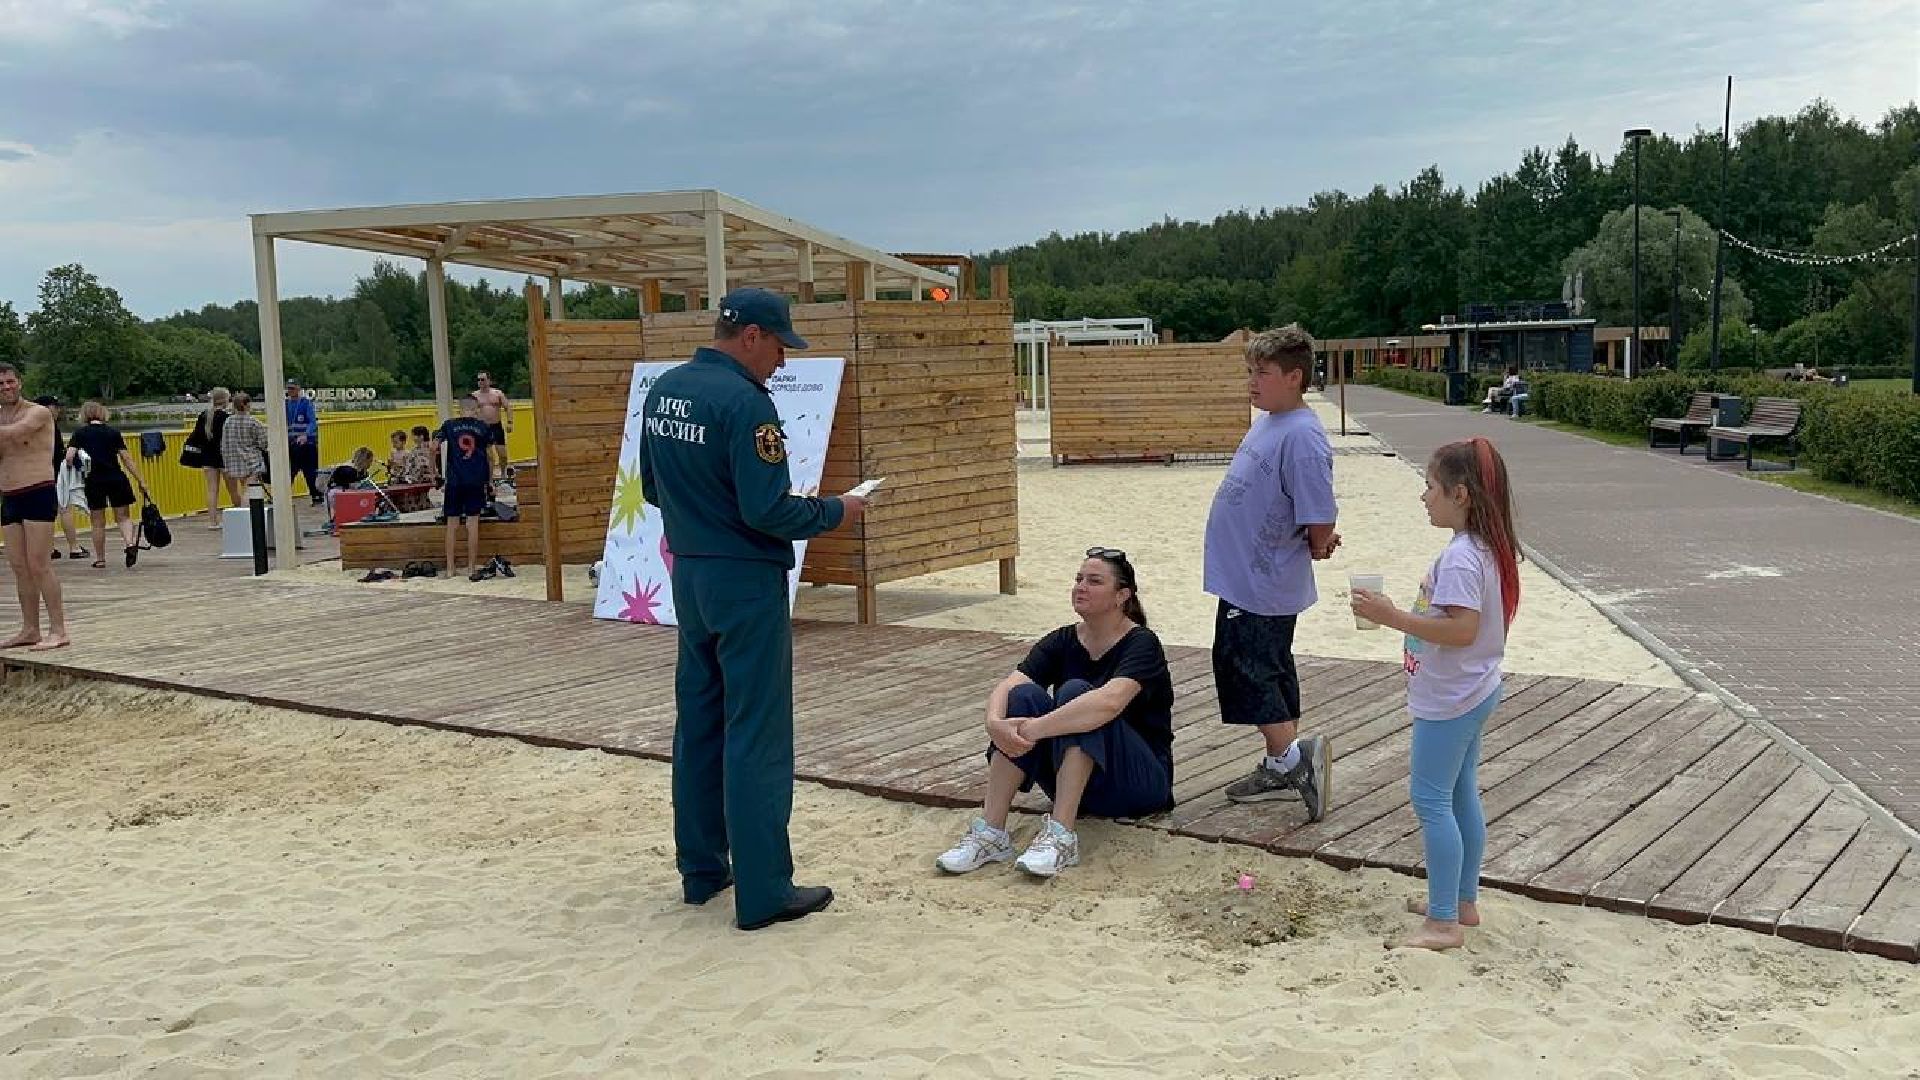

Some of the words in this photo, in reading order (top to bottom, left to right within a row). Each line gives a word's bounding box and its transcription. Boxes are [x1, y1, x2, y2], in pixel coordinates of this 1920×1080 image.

[656, 396, 692, 418] МЧС
[646, 417, 706, 444] РОССИИ
[458, 433, 476, 460] 9
